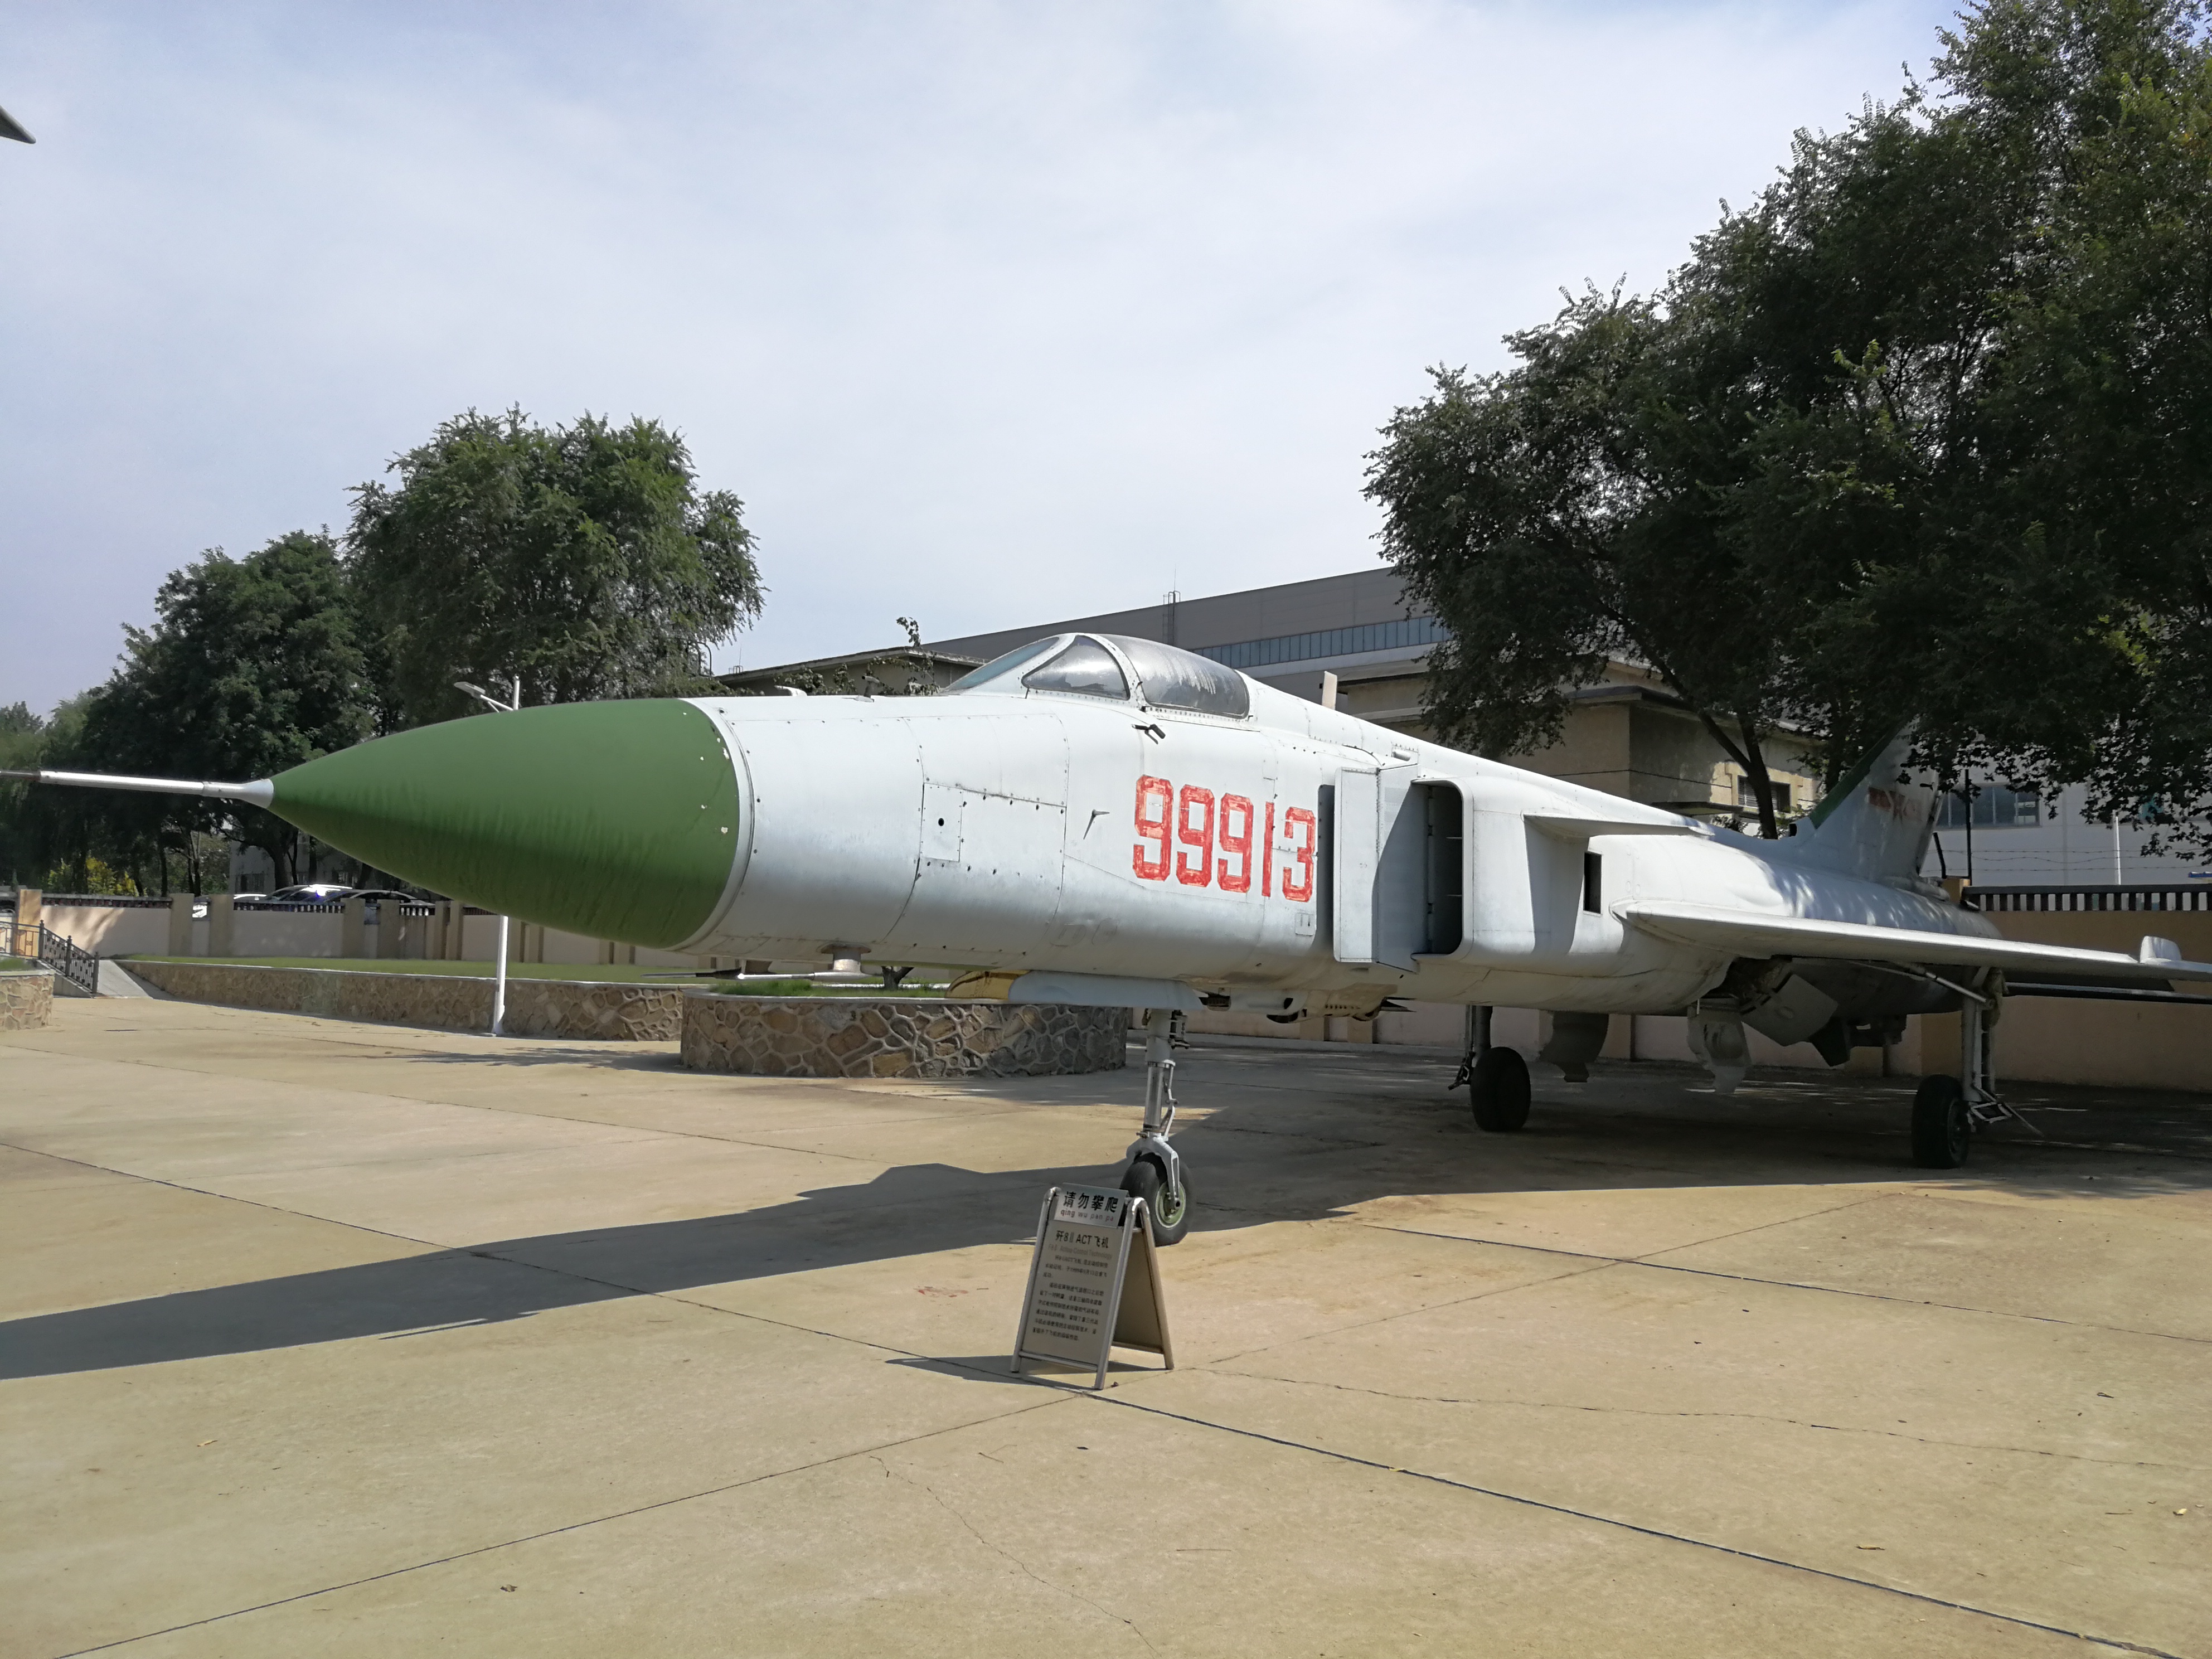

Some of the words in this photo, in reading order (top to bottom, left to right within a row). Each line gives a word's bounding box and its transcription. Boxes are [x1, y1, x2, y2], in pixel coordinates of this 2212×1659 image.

[1132, 774, 1316, 902] 99913
[1063, 1191, 1118, 1213] 请勿攀爬
[1060, 1209, 1075, 1218] qing
[1075, 1234, 1092, 1245] ACT
